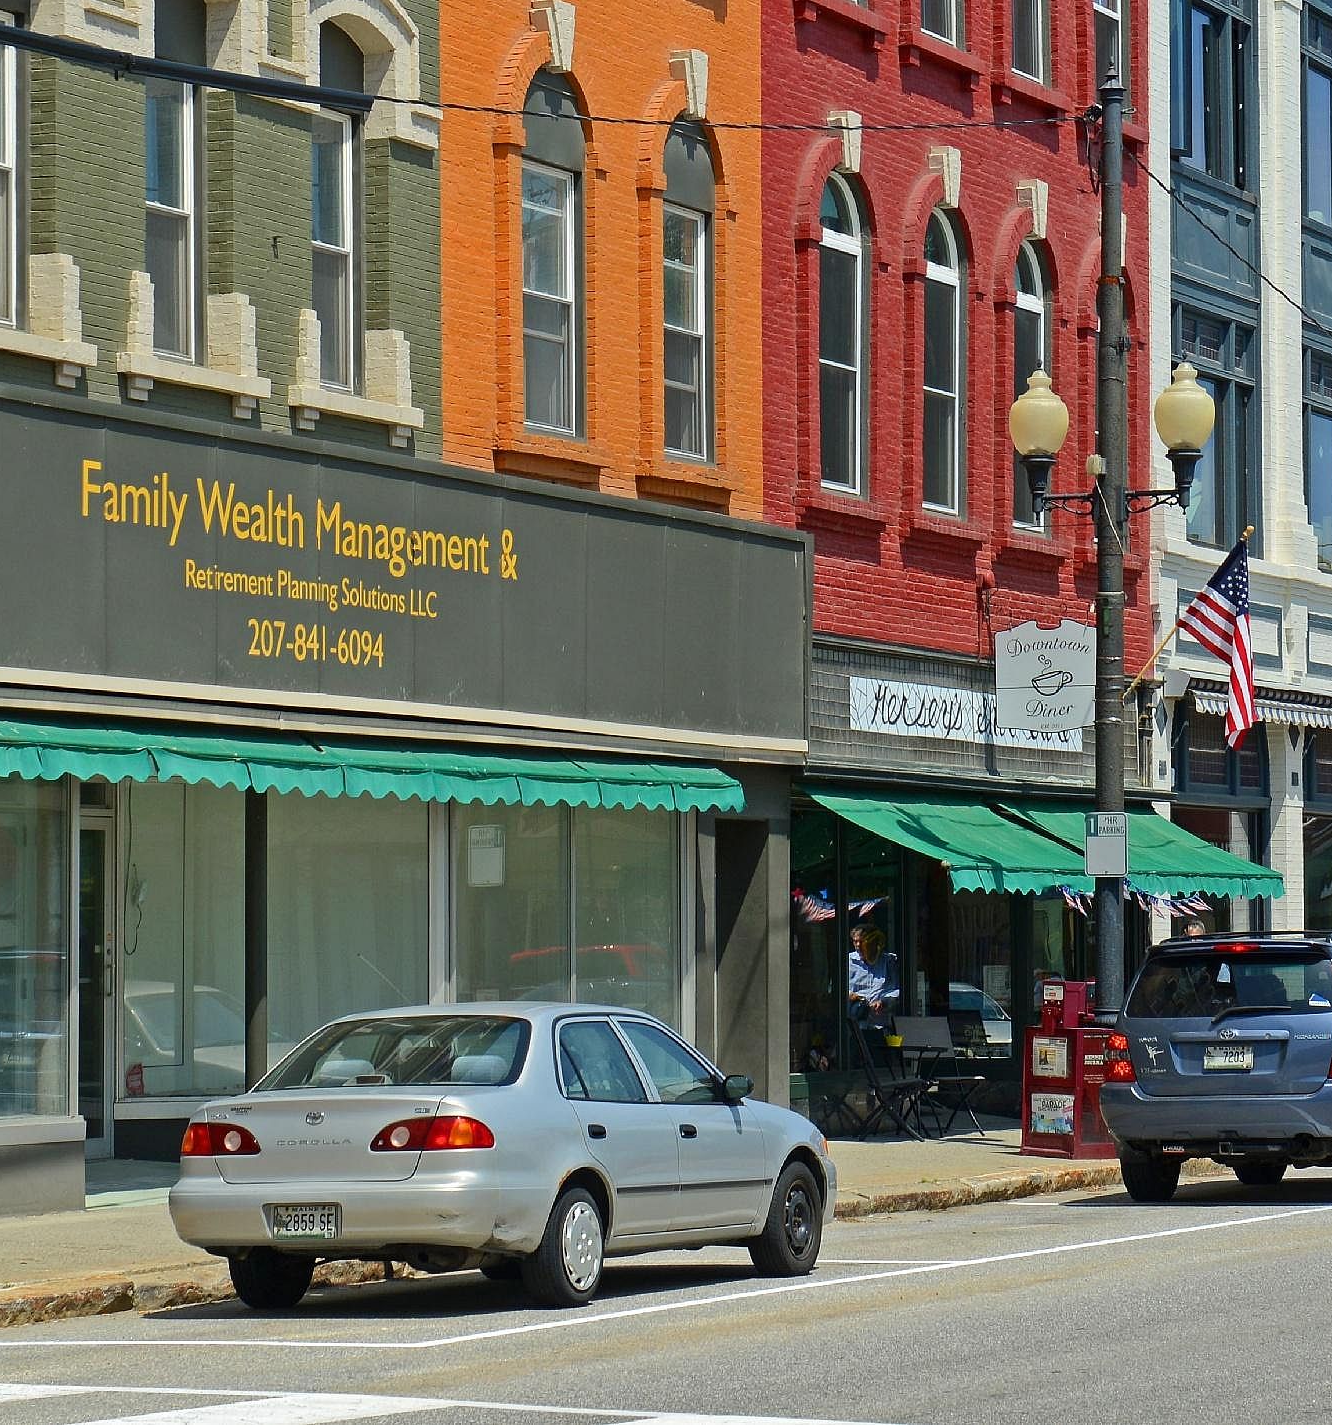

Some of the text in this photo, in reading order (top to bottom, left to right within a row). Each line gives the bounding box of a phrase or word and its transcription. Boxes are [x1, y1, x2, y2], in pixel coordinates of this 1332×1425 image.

[81, 458, 518, 581] Family Wealth Management &
[185, 559, 438, 618] Retirement Planning Solutions LLC
[247, 618, 385, 669] 207-841-6094
[1007, 637, 1090, 658] Downtown
[1025, 699, 1075, 718] Diner
[1098, 826, 1125, 835] PARKING
[1223, 1051, 1245, 1063] 7203
[276, 1139, 353, 1147] COROLLA
[285, 1213, 335, 1232] 2859 SE
